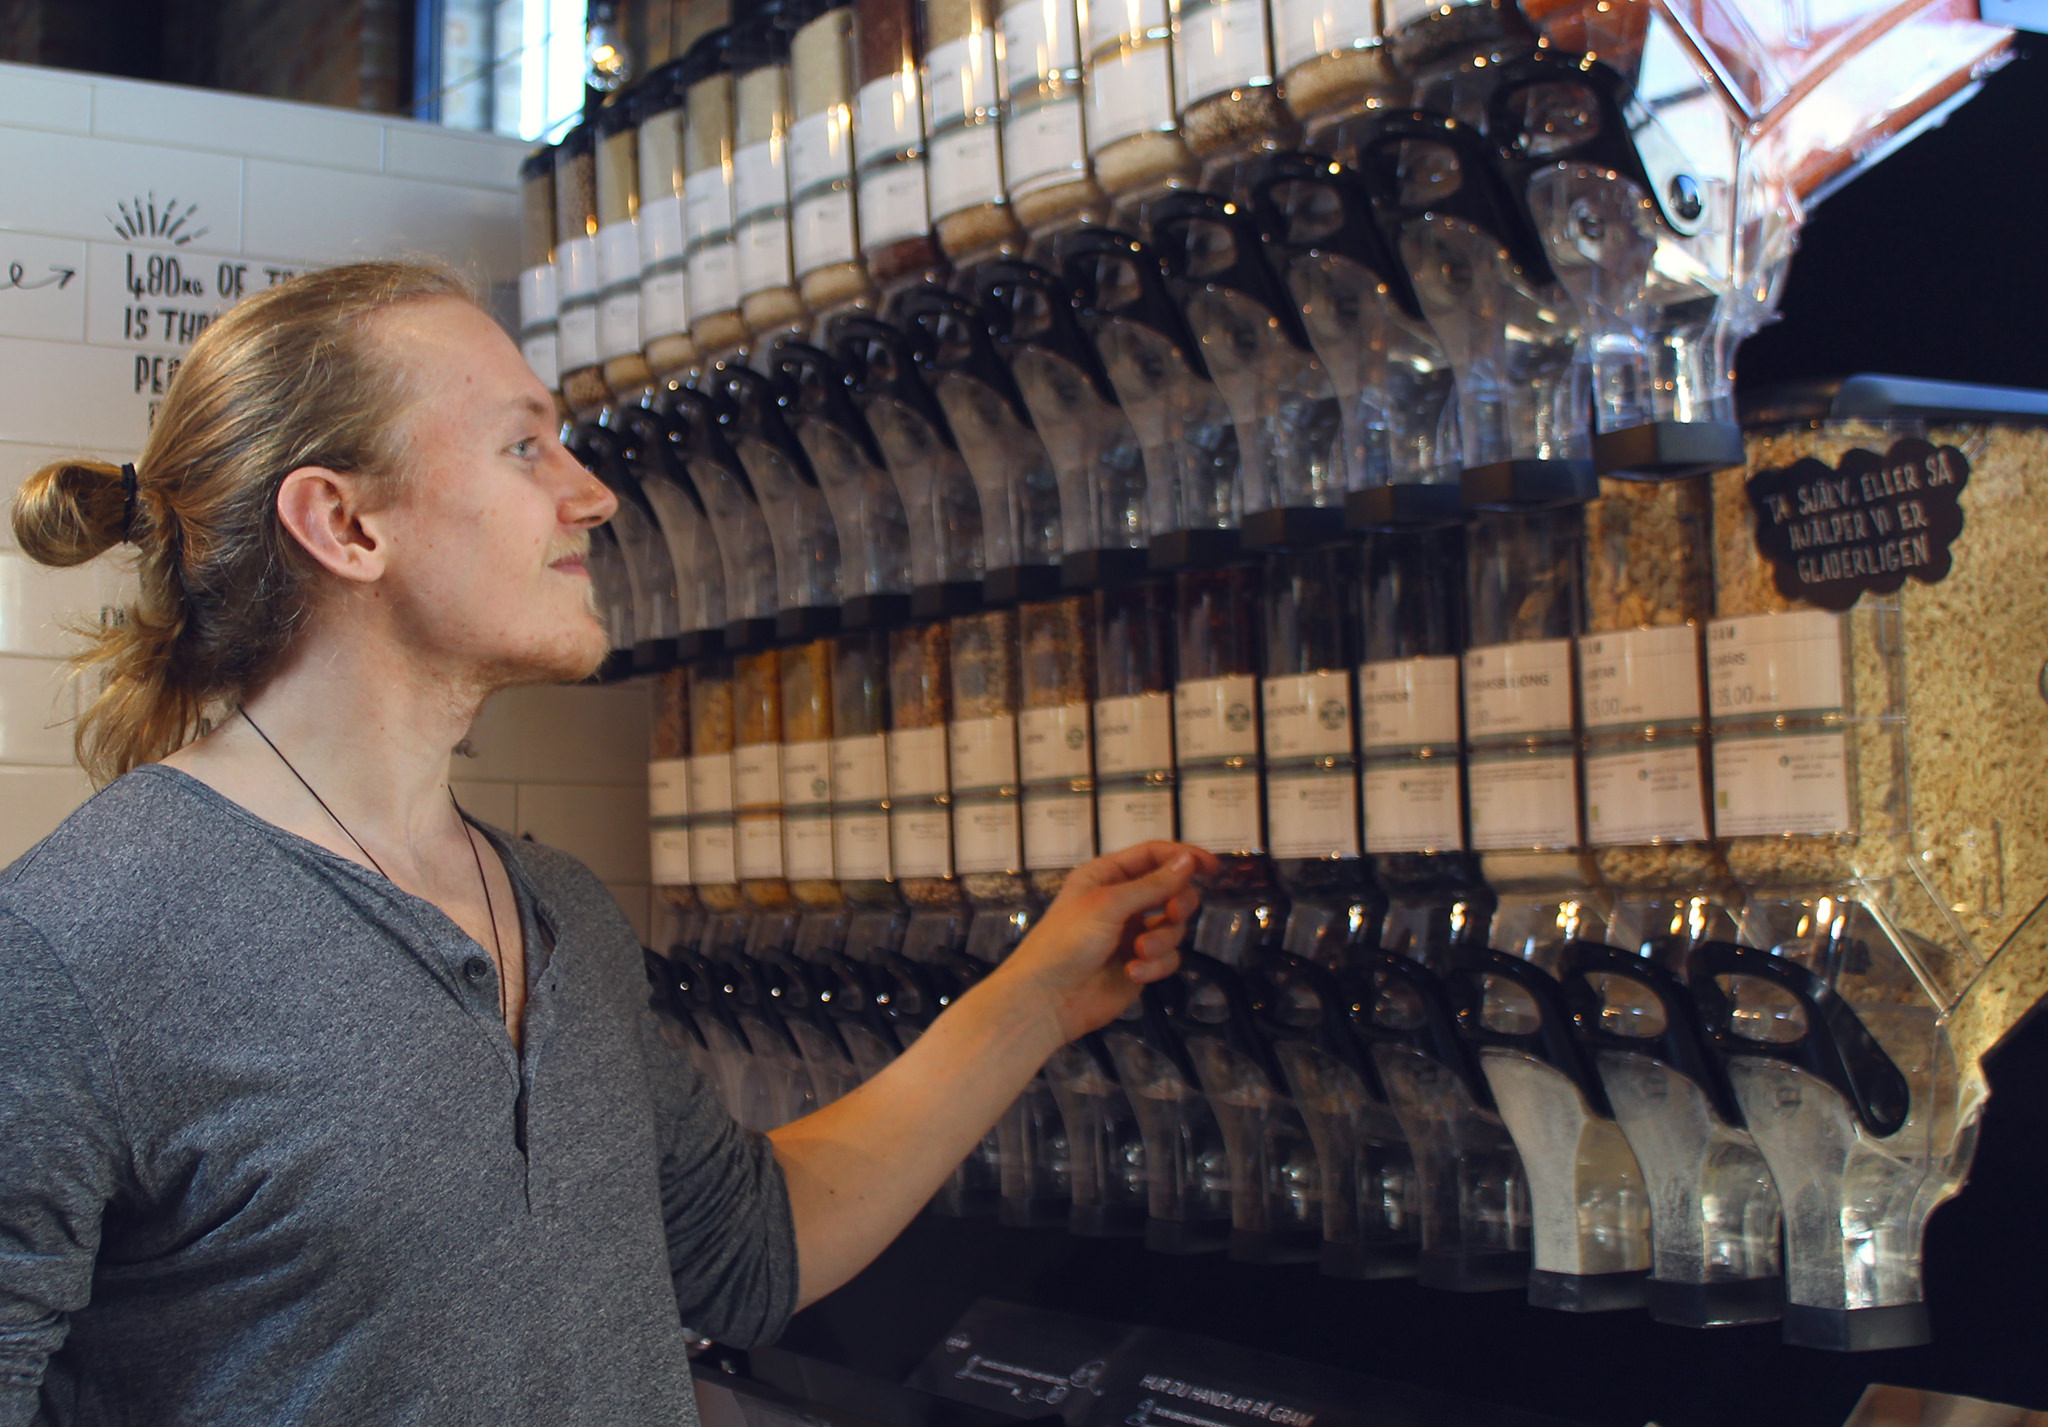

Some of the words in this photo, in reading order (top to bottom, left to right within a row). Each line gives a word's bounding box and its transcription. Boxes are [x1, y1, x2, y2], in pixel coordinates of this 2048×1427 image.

[217, 263, 247, 300] OF
[125, 307, 148, 340] IS
[1860, 463, 1922, 502] ELLER
[1869, 506, 1892, 536] VI
[1897, 499, 1929, 530] ER
[1167, 1379, 1193, 1397] DU
